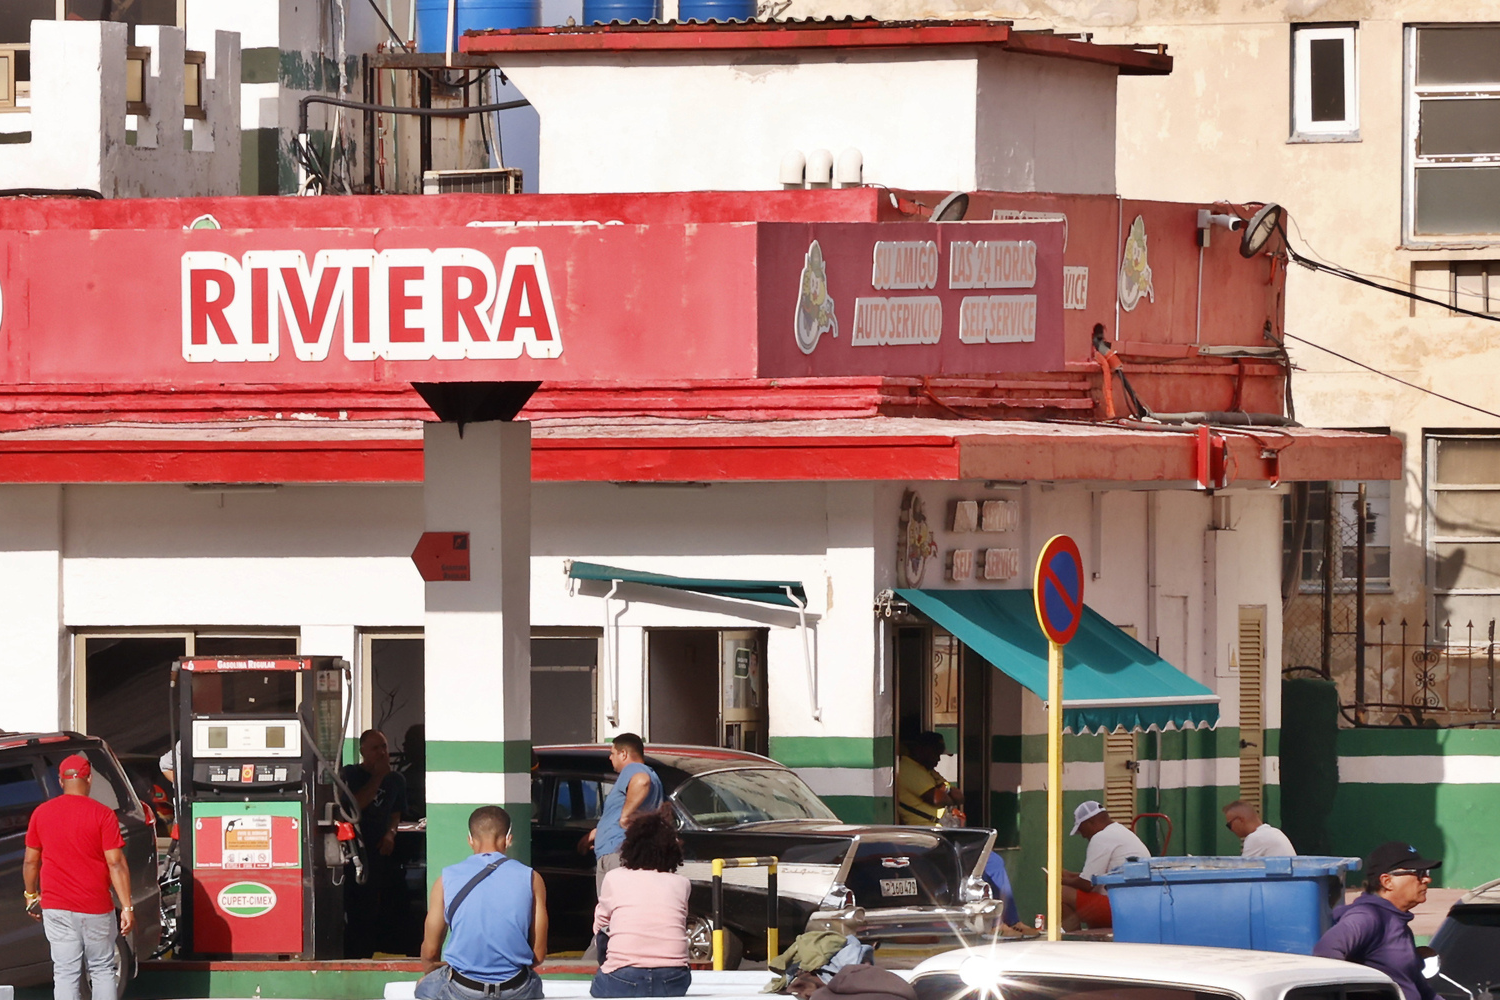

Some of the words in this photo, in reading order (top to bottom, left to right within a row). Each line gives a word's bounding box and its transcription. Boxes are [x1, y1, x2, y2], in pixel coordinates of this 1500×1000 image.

[874, 246, 891, 285] SU
[894, 245, 937, 284] AMIGO
[951, 245, 973, 283] LAS
[976, 245, 992, 283] 24
[994, 244, 1035, 282] HORAS
[186, 256, 559, 353] RIVIERA
[988, 300, 1035, 337] SERVICE
[221, 896, 273, 906] CUPET-CIMEX
